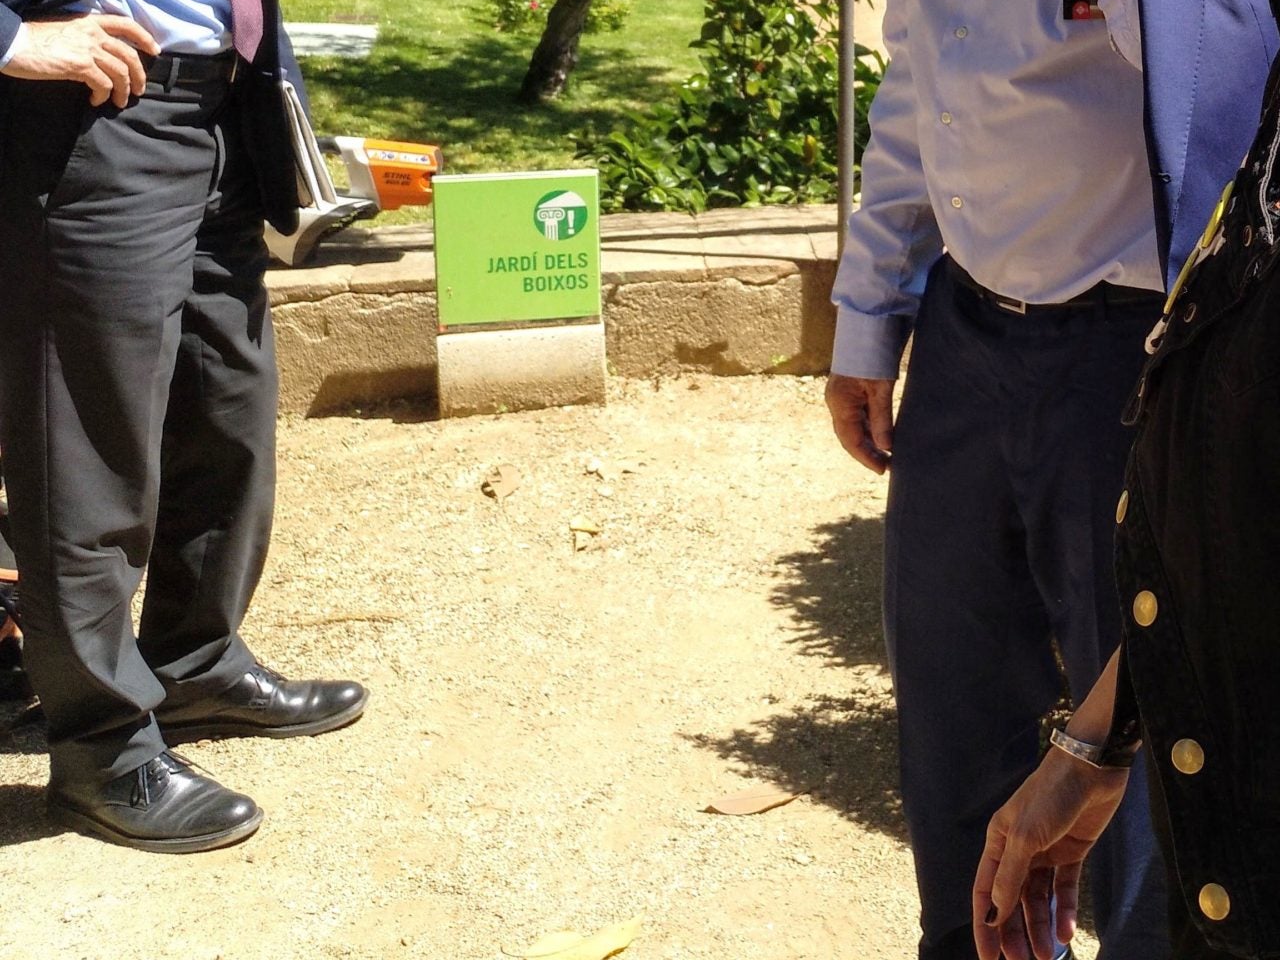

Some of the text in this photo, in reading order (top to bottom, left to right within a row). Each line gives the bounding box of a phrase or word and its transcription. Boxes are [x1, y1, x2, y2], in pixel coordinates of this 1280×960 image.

[487, 251, 589, 273] JARDÍ DELS
[523, 273, 589, 293] BOIXOS
